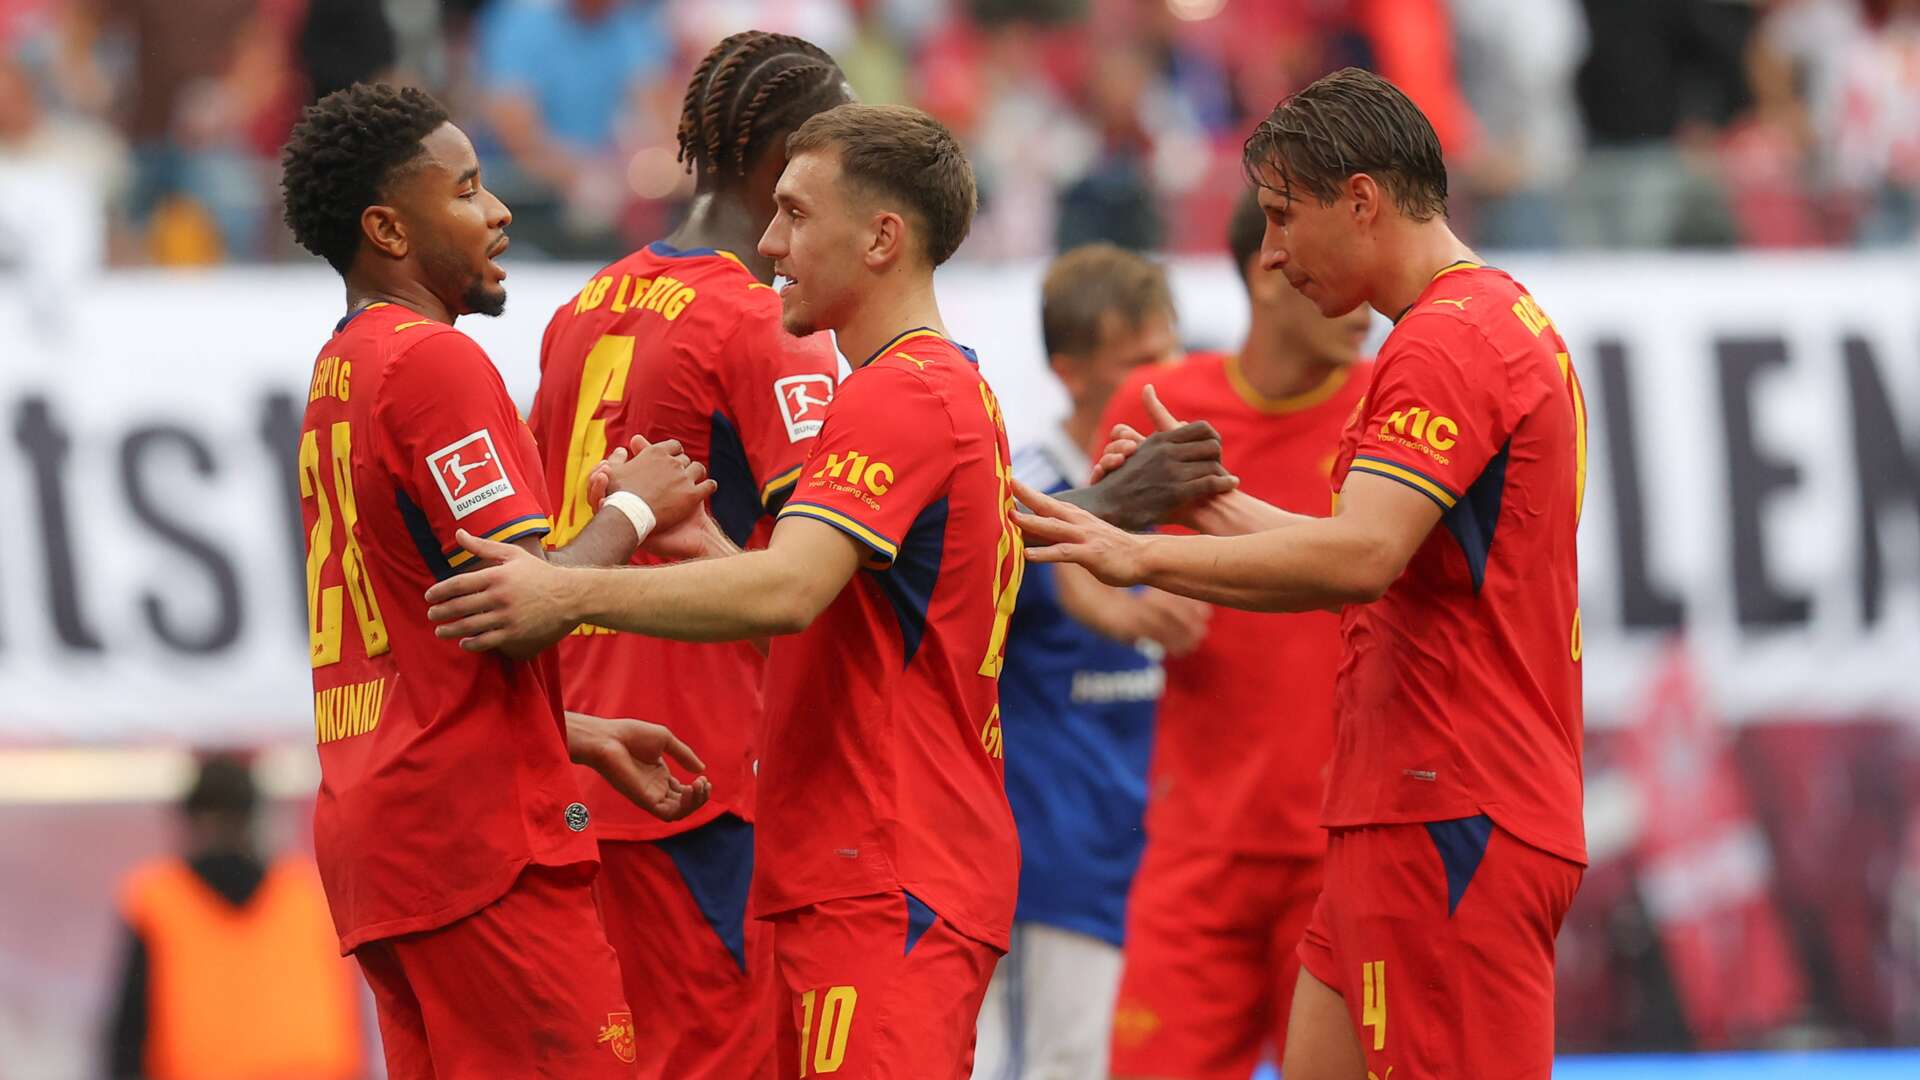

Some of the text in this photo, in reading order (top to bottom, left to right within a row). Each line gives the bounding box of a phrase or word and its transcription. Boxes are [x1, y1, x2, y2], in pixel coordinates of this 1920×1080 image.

[610, 274, 697, 321] LEPZIG
[456, 483, 508, 512] BUNDESLIGA
[315, 677, 385, 745] NKUNKU
[800, 985, 858, 1079] 10
[1362, 960, 1387, 1051] 4
